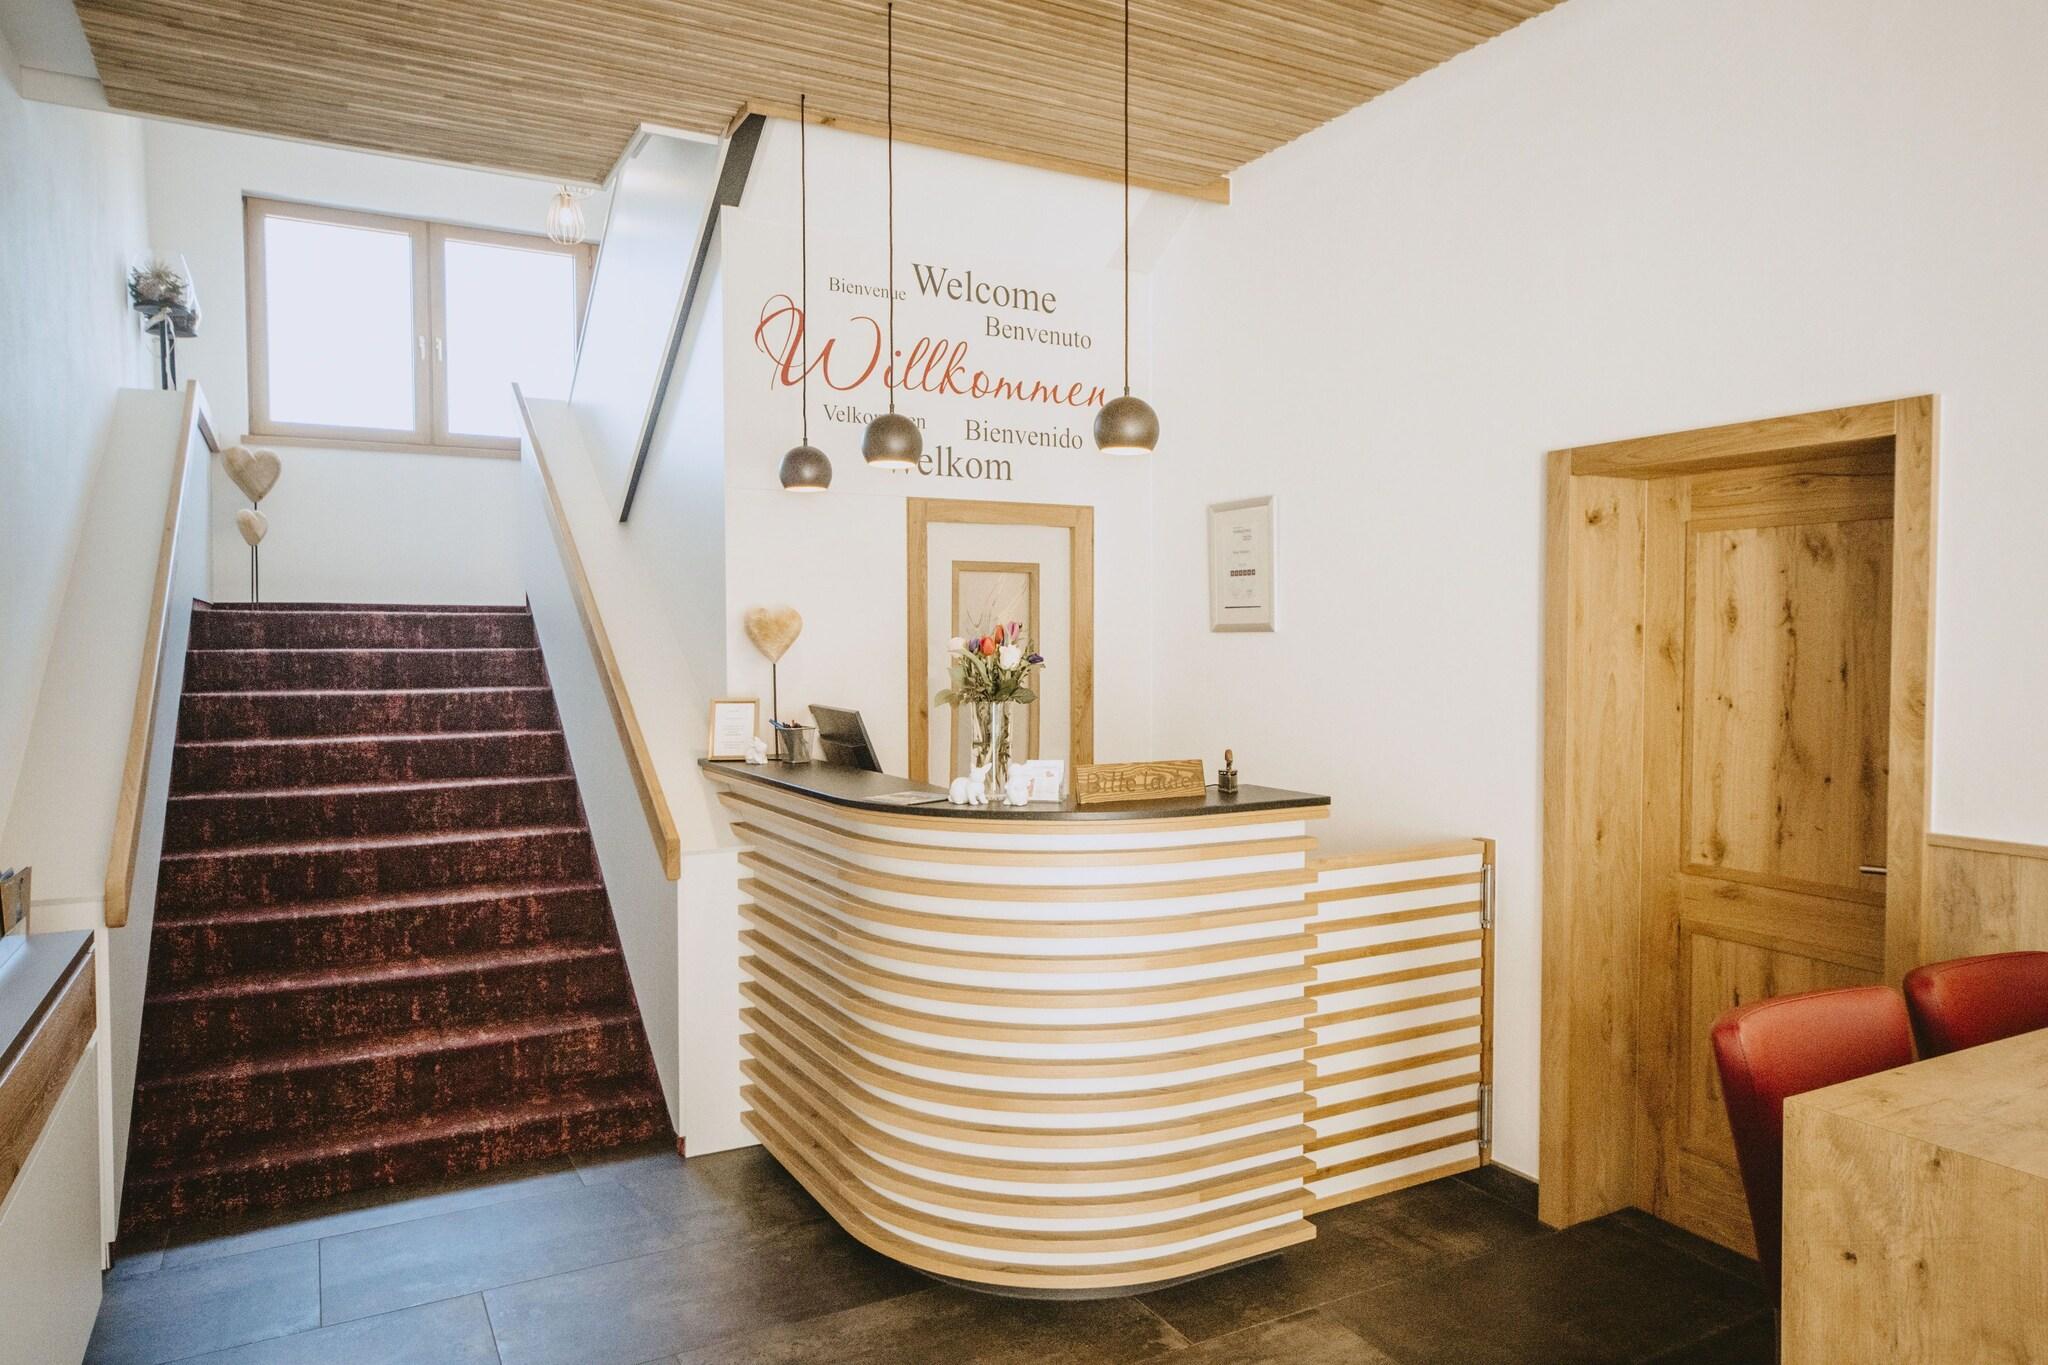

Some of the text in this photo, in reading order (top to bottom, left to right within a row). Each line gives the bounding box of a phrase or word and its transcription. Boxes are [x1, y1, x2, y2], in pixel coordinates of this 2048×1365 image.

[829, 277, 907, 301] Bienvenue
[912, 263, 1057, 314] Welcome
[985, 315, 1092, 350] Benvenuto
[754, 294, 1105, 408] Willkommen
[965, 419, 1083, 450] Bienvenido
[891, 445, 1013, 481] elkom
[1087, 770, 1137, 793] Bitte
